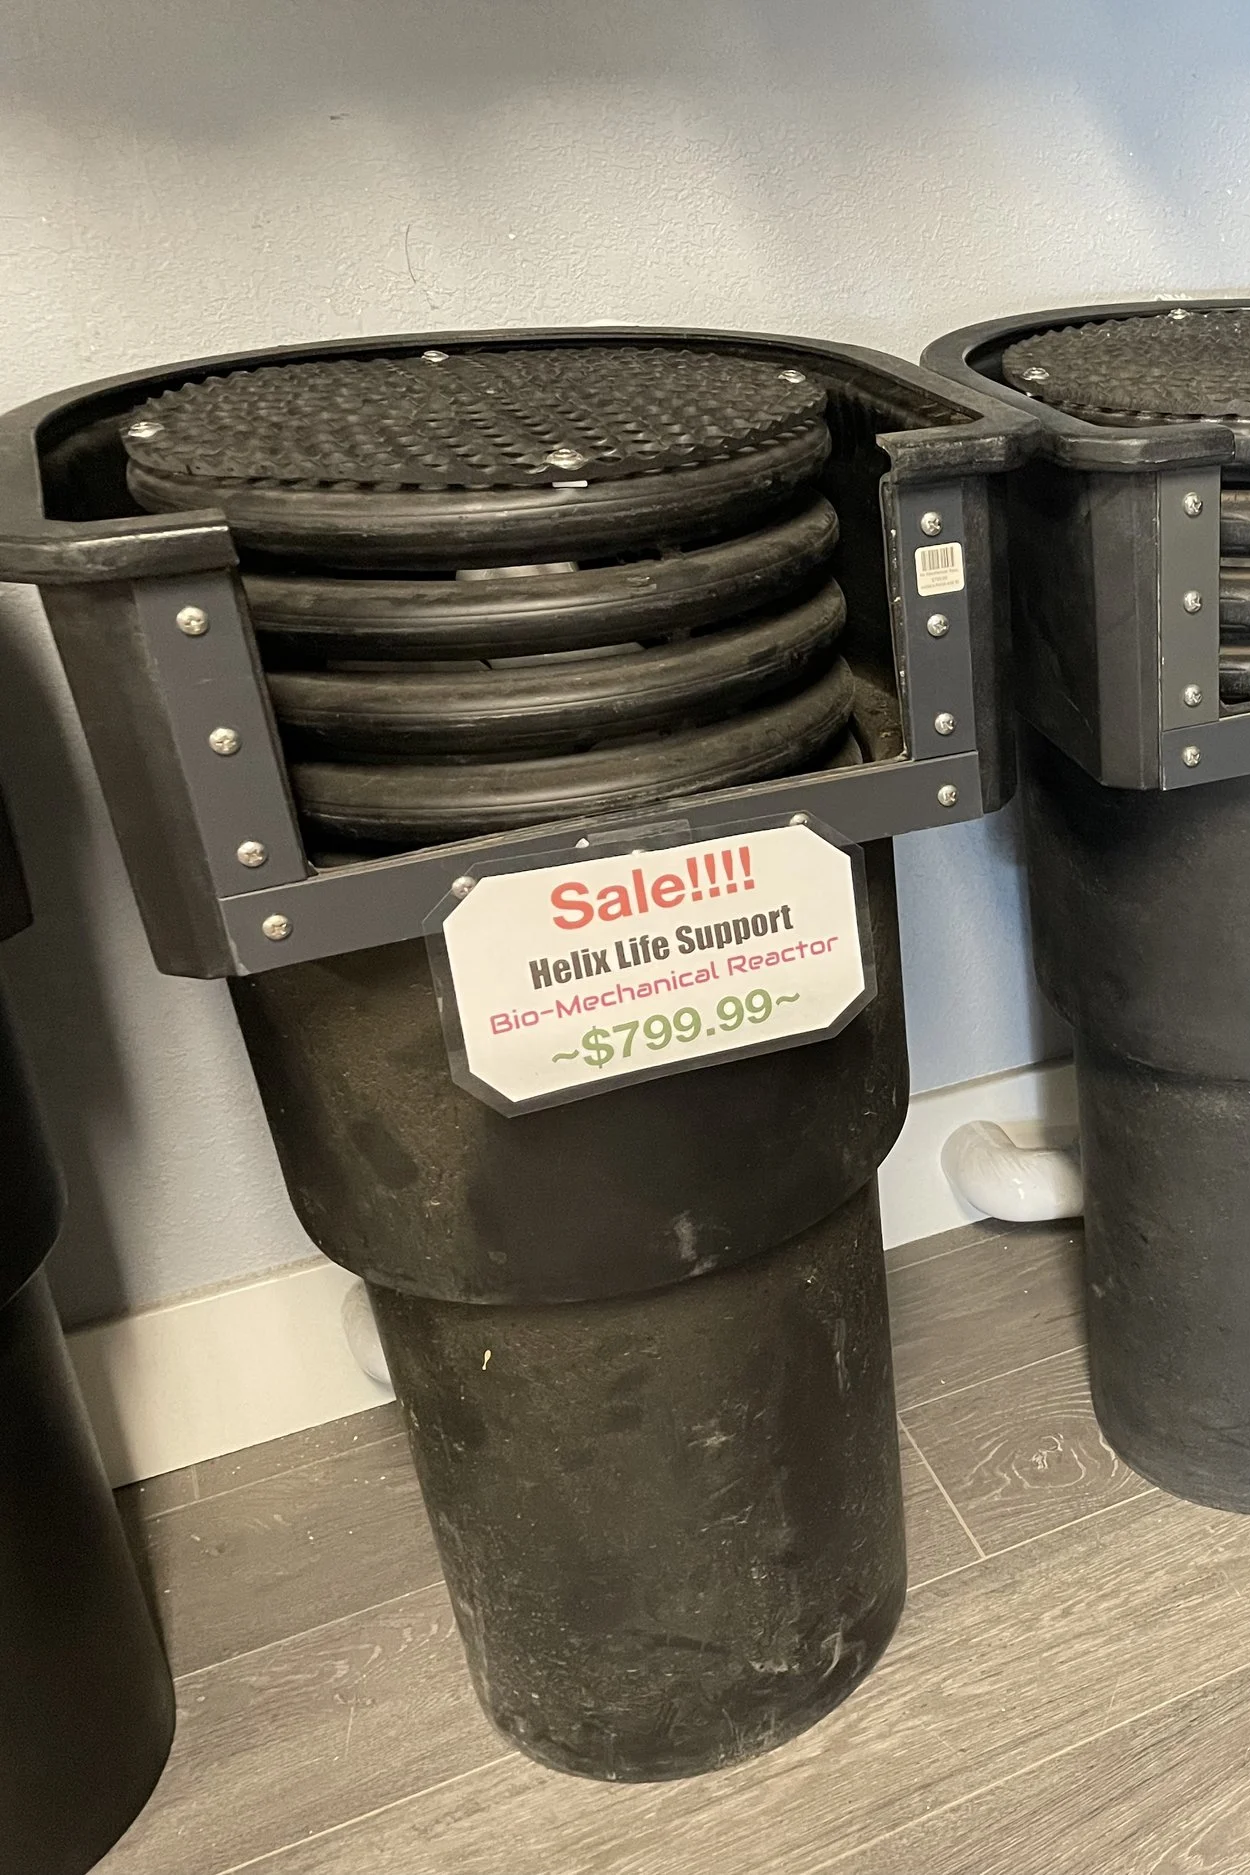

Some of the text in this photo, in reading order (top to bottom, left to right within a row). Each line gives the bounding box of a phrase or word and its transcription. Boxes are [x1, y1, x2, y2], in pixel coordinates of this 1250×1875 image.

[550, 846, 756, 930] Sale!!!!
[489, 936, 839, 1036] Bio-Mechanical Reactor
[529, 904, 794, 990] Helix Life Support
